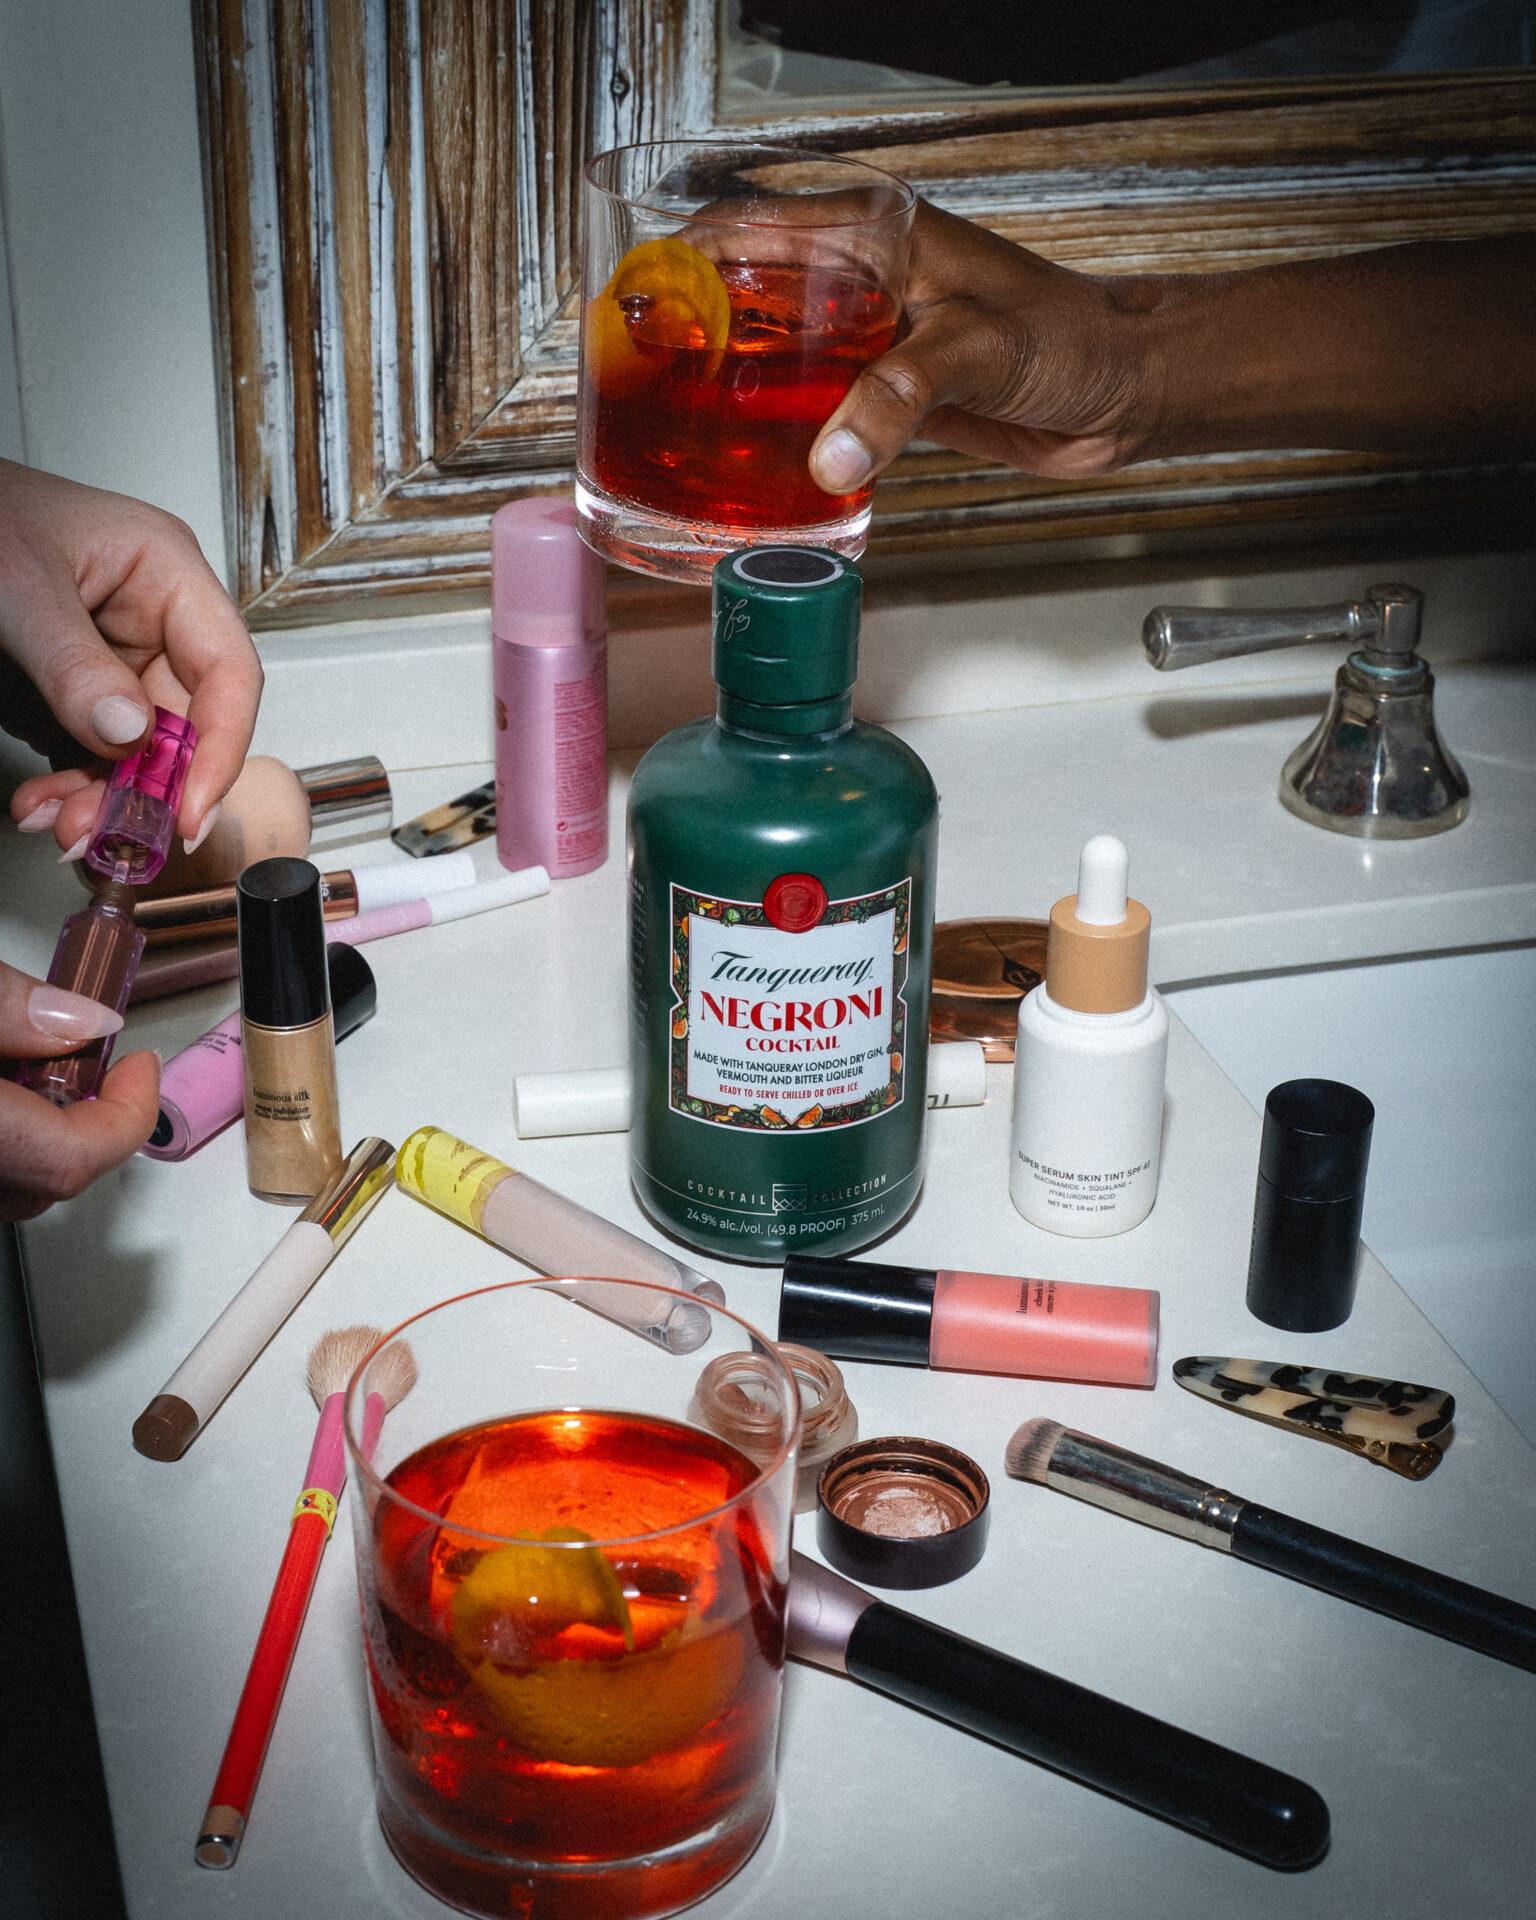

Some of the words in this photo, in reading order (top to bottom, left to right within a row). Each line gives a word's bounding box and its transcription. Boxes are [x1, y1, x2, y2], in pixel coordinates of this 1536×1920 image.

[711, 951, 875, 993] Tanqueray
[699, 985, 883, 1032] NEGRONI
[745, 1035, 840, 1053] COCKTAIL
[693, 1050, 719, 1065] MADE
[720, 1056, 744, 1069] WITH
[746, 1061, 804, 1073] TANQUERAY
[805, 1057, 848, 1072] LONDON
[849, 1052, 867, 1067] DRY
[867, 1046, 884, 1060] GIN,
[716, 1069, 768, 1085] VERMOUTH
[769, 1074, 793, 1085] AND
[794, 1073, 824, 1085] BITTER
[826, 1065, 864, 1082] LIQUEUR
[294, 1090, 310, 1101] silk
[719, 1084, 742, 1097] READY
[744, 1088, 754, 1098] TO
[756, 1089, 780, 1100] SERVE
[781, 1088, 812, 1100] CHILLED
[814, 1087, 825, 1098] OR
[826, 1084, 846, 1097] OVER
[847, 1082, 858, 1092] ICE
[1018, 1150, 1039, 1171] SUPER
[1041, 1165, 1075, 1181] SERUM
[1077, 1174, 1101, 1182] SKIN
[1104, 1172, 1125, 1182] TINT
[1126, 1166, 1143, 1178] SPF
[687, 1179, 767, 1205] COCKTAIL
[812, 1173, 887, 1204] COLLECTION
[1033, 1173, 1080, 1191] NIACINAMIDE
[1088, 1182, 1127, 1192] SQUALANE
[1047, 1199, 1060, 1208] NET
[1049, 1189, 1096, 1201] HYALURONIC
[686, 1208, 717, 1227] 24.9%
[719, 1218, 764, 1235] alc./vol.
[767, 1222, 796, 1237] (49.8
[800, 1218, 846, 1234] PROOF)
[851, 1210, 869, 1225] 375
[870, 1204, 886, 1219] mL
